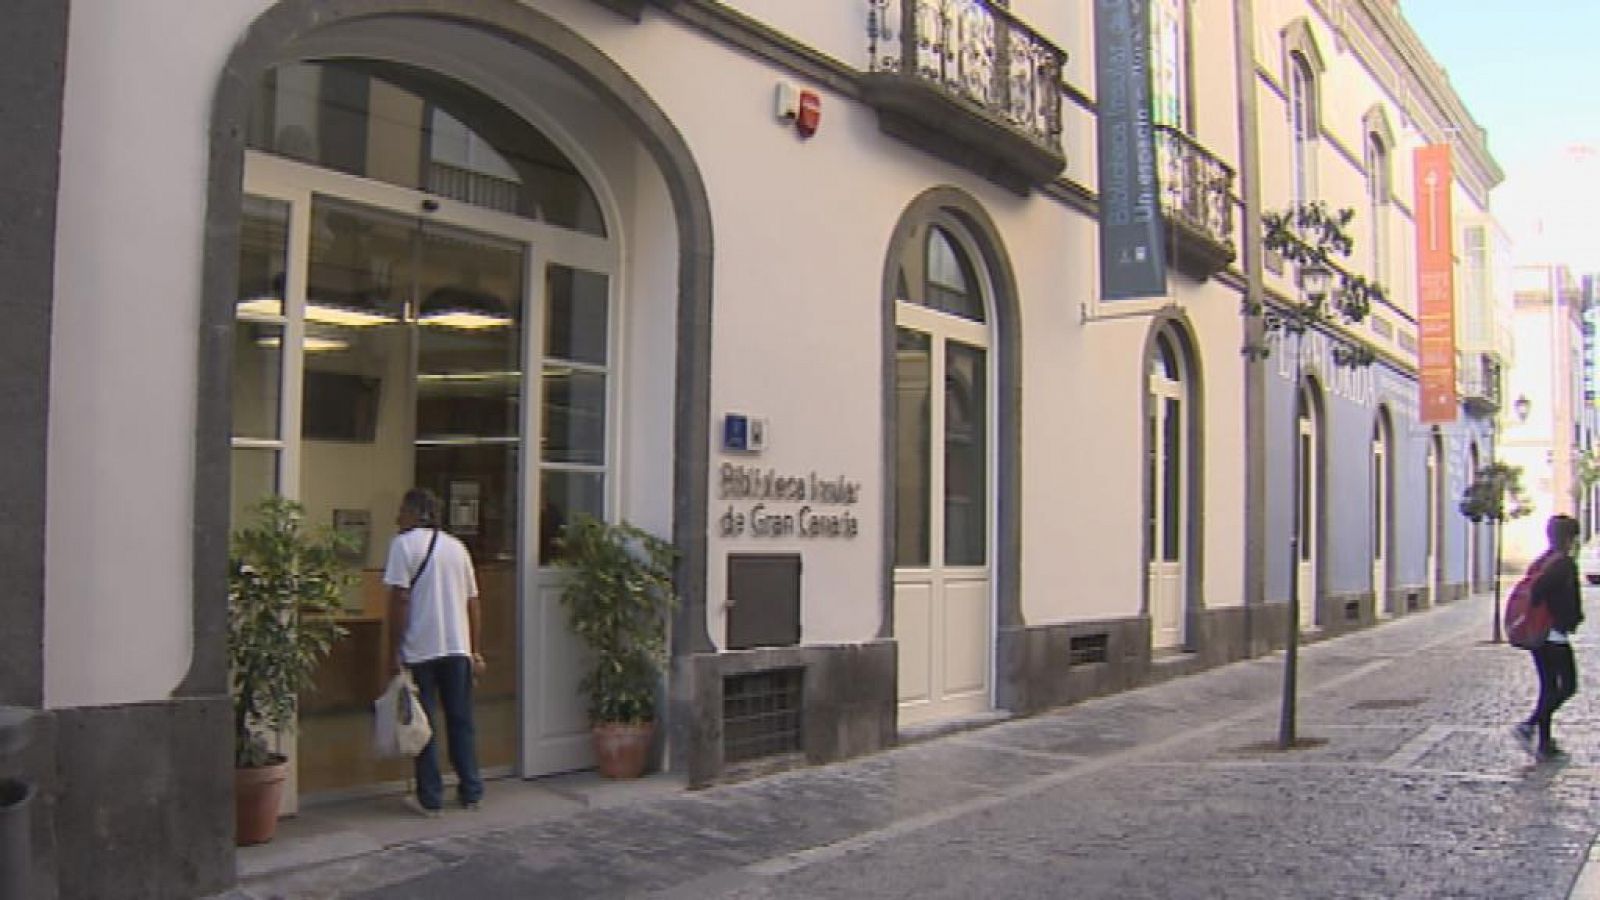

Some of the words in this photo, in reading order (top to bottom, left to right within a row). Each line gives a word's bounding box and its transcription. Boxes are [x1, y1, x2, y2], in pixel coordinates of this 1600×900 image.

[720, 462, 805, 500] Biblioteca
[810, 471, 860, 503] Insular
[720, 505, 745, 537] de
[751, 503, 794, 537] Gran
[800, 506, 858, 538] Canaria
